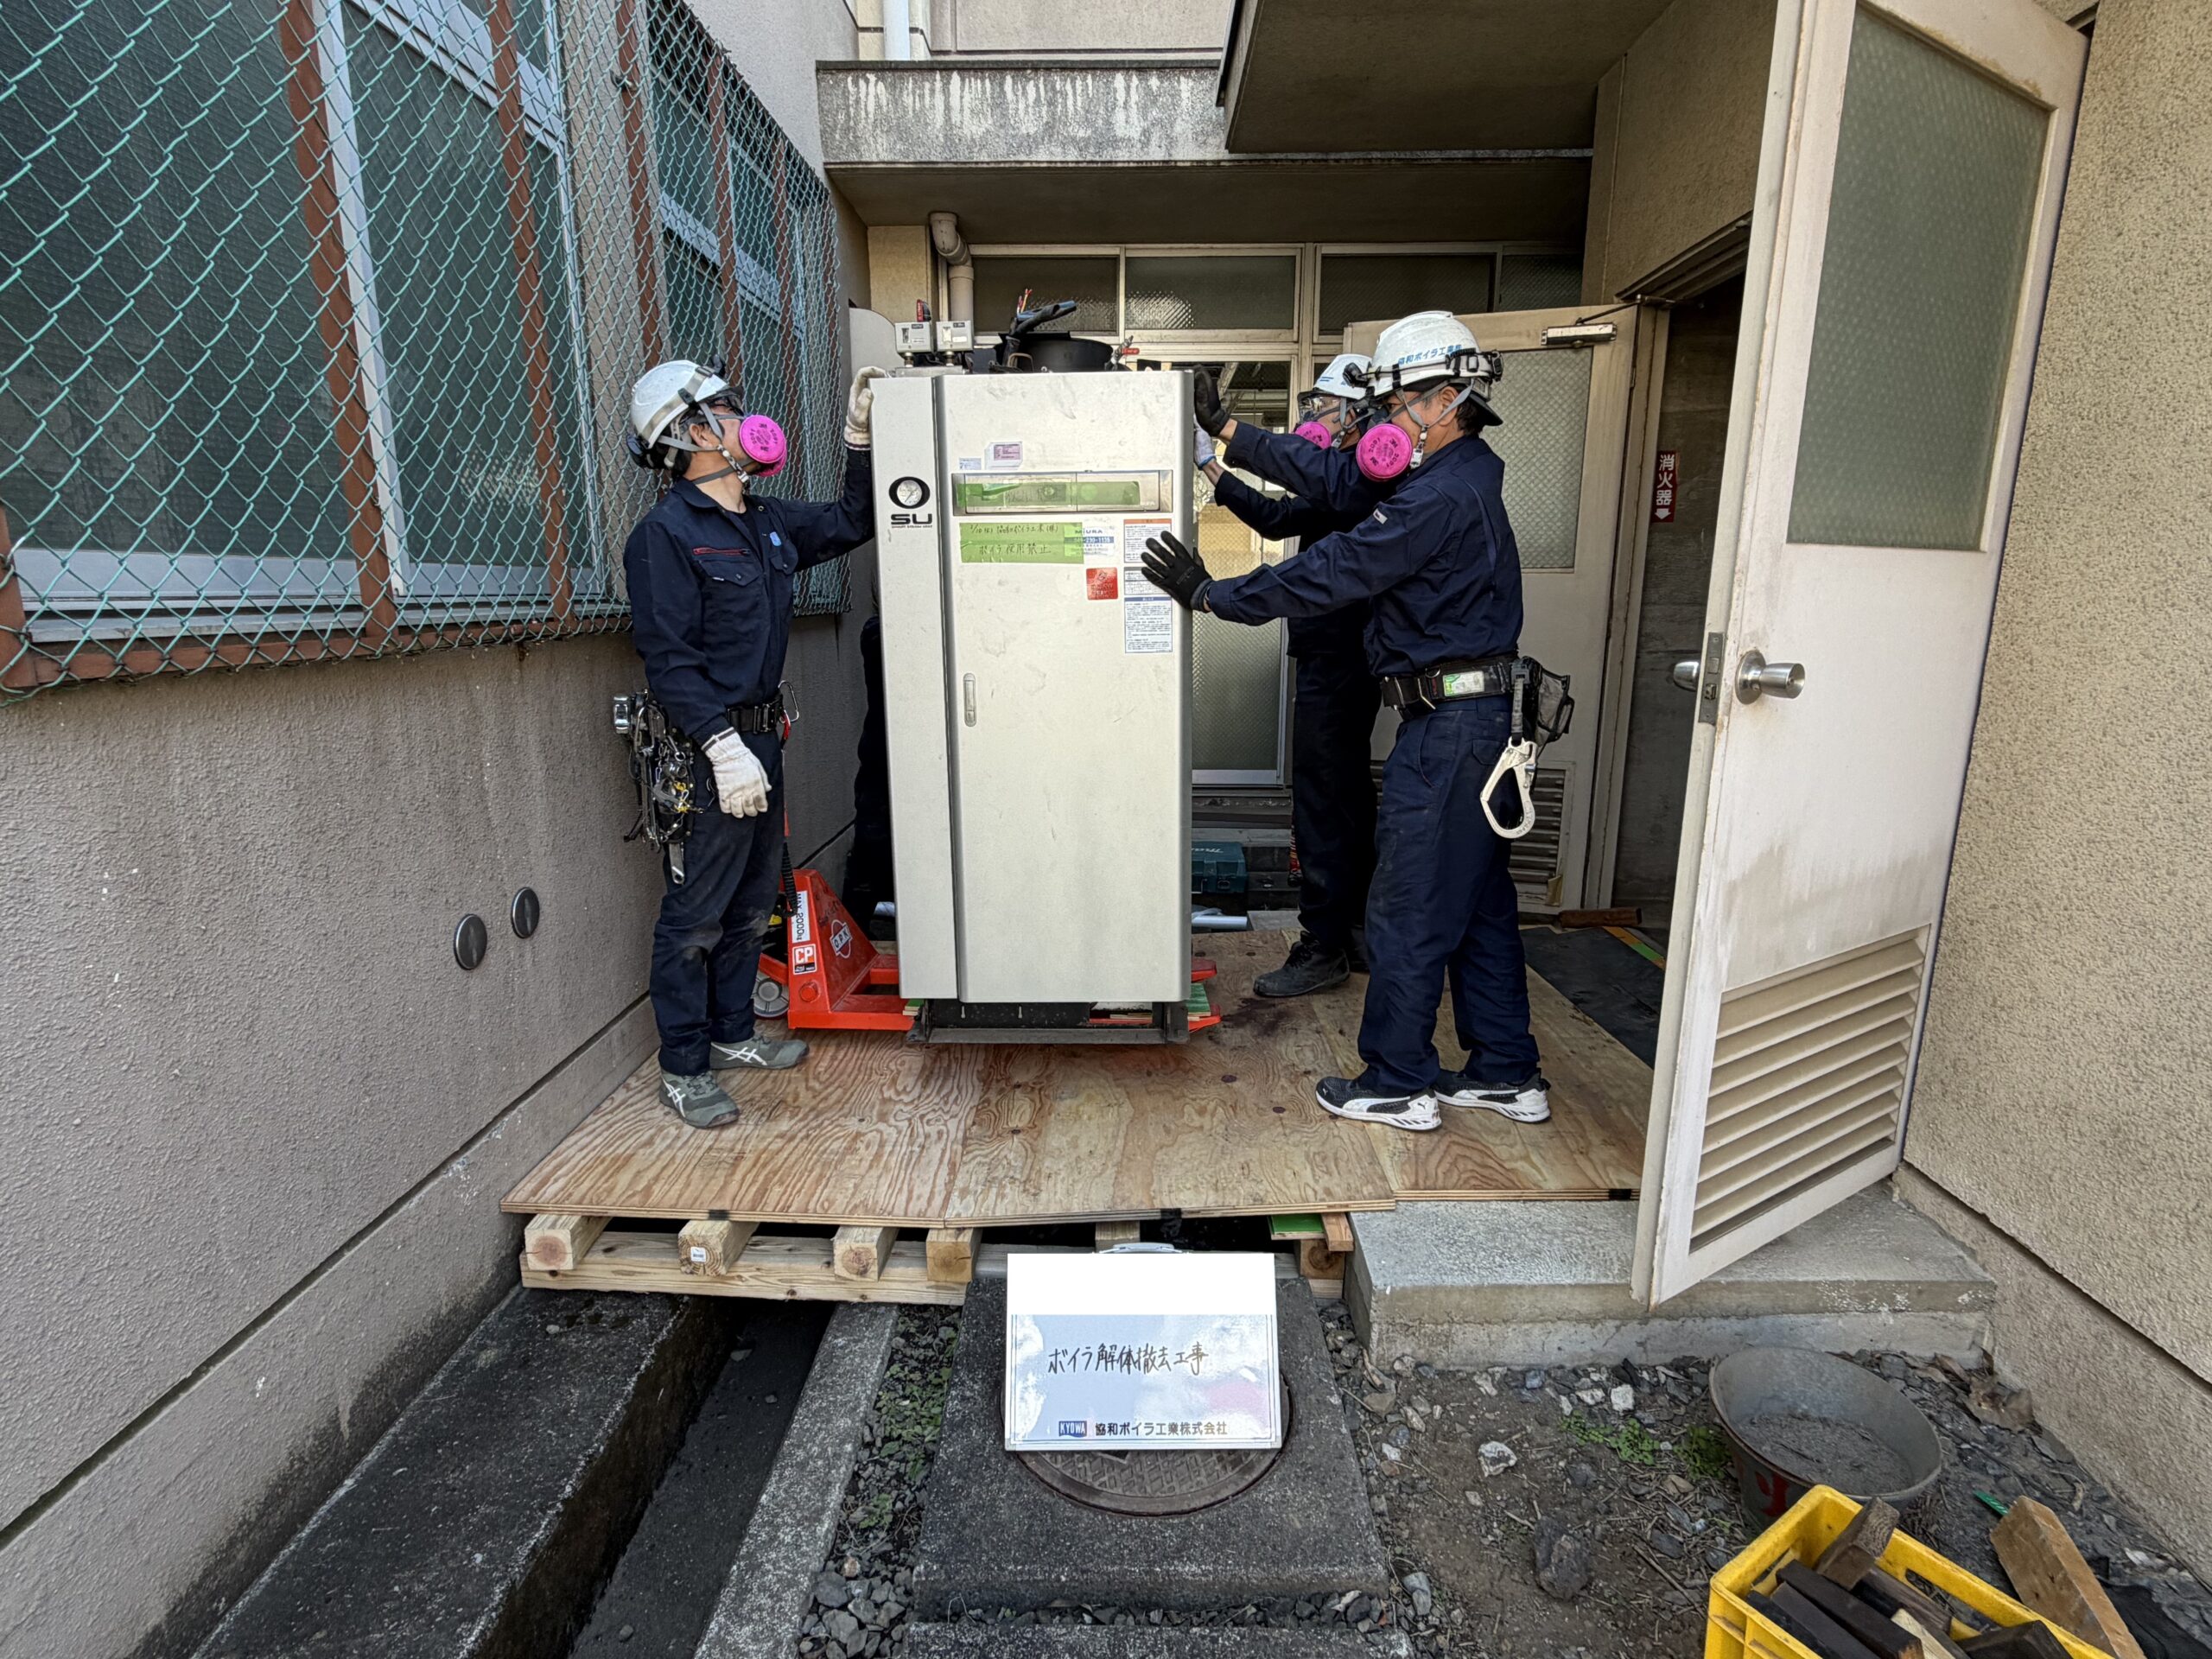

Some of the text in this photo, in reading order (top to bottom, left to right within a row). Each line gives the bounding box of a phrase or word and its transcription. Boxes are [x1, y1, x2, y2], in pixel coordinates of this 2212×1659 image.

[1656, 454, 1675, 506] 消火器
[890, 513, 933, 525] SU
[795, 946, 815, 964] CP
[1047, 1341, 1210, 1376] ボイラ解体撤去工事
[1059, 1421, 1086, 1435] KYOWA
[1095, 1421, 1228, 1437] 協和ボイラ工業株式会社
